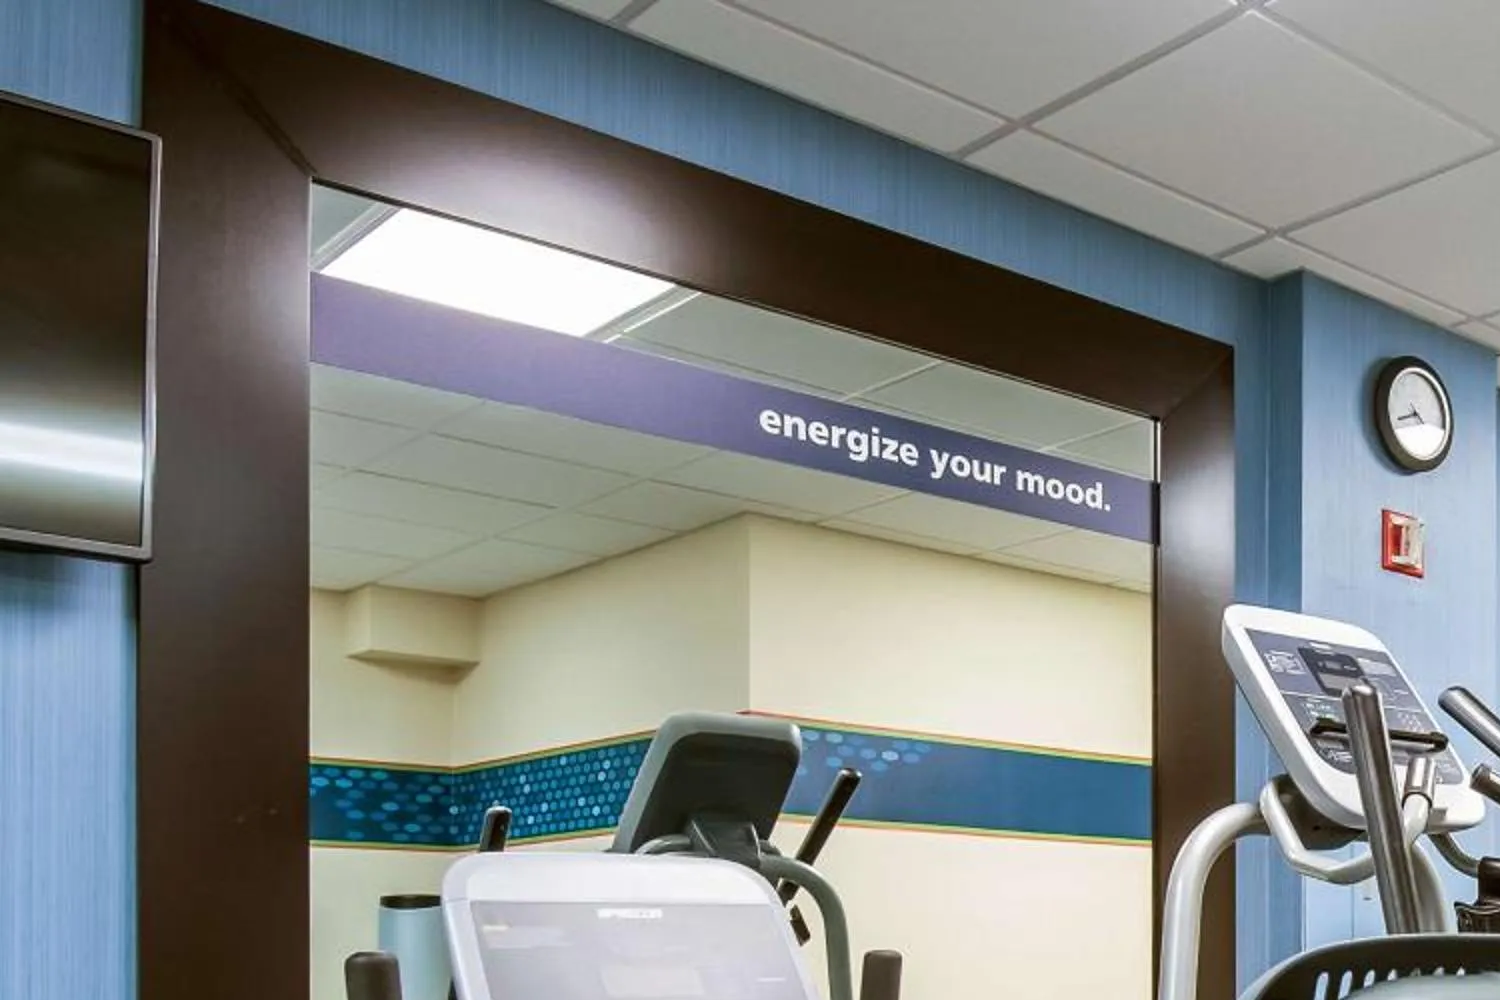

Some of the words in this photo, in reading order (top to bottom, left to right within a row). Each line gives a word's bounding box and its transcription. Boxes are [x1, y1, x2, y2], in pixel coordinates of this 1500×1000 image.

[759, 407, 919, 467] energize
[929, 448, 1007, 486] your
[1015, 468, 1112, 511] mood.
